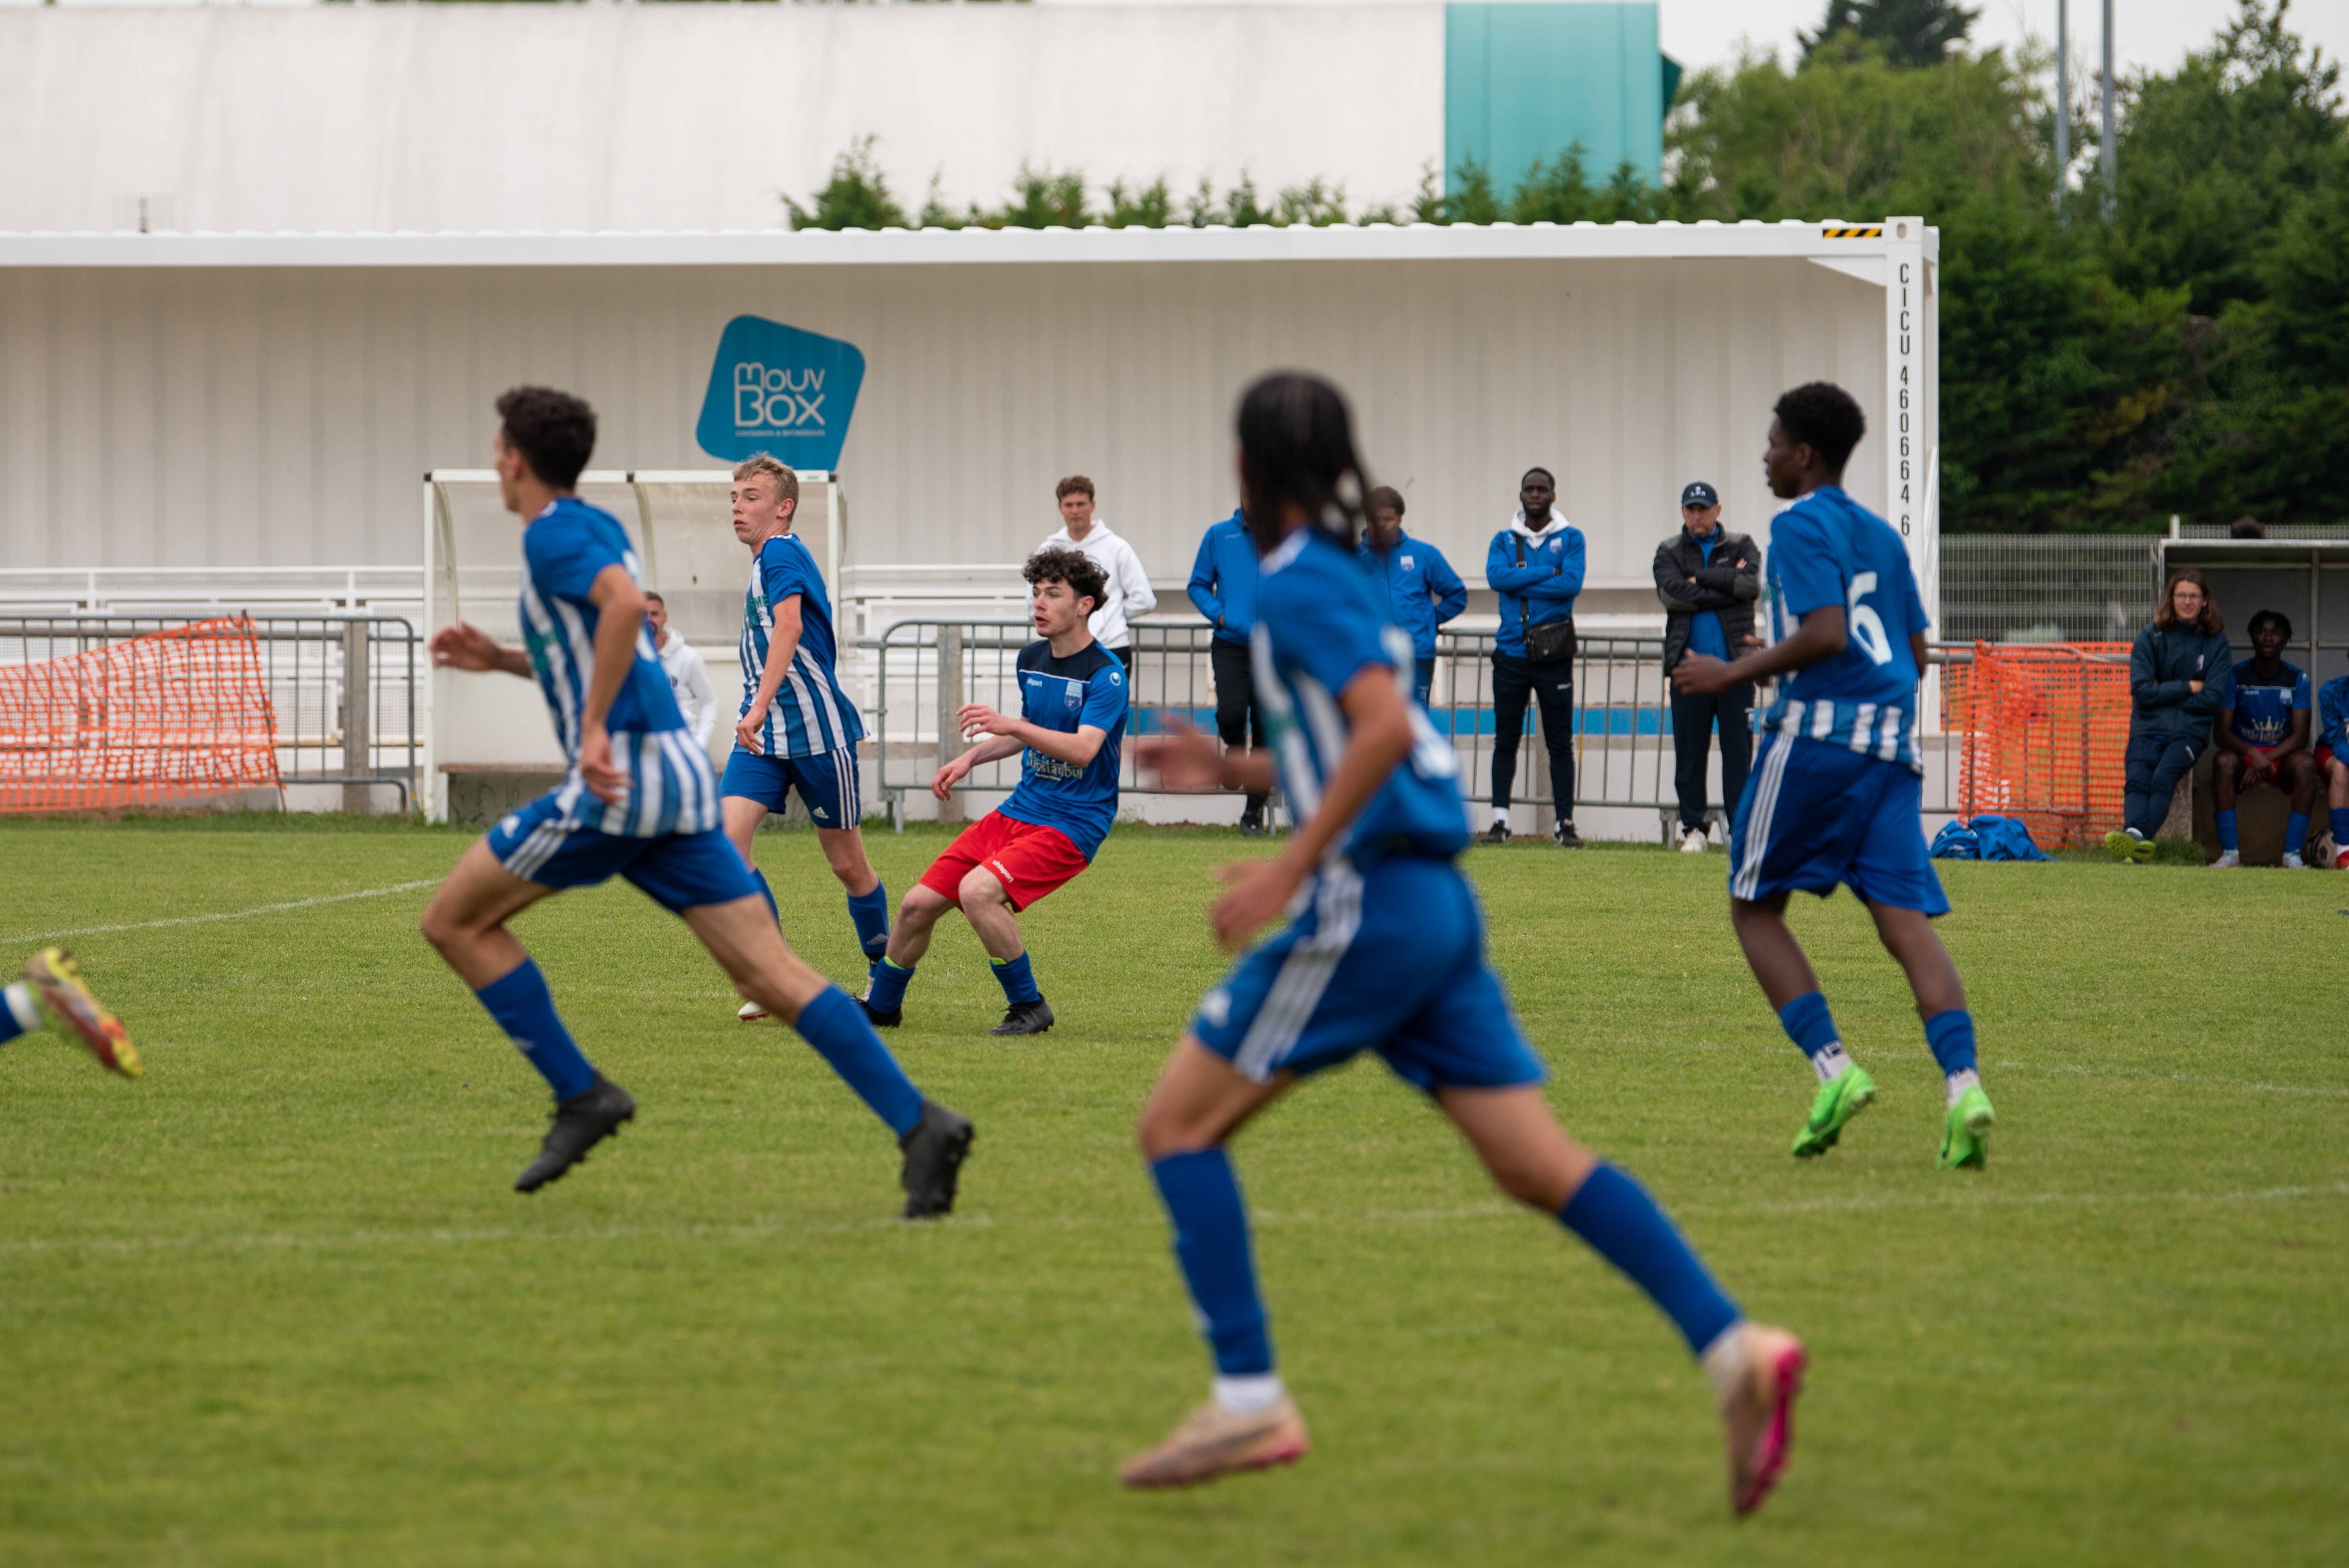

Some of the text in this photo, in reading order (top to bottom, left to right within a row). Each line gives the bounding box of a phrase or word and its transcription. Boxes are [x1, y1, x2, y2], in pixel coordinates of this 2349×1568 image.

[1900, 263, 1910, 537] CICU 460664 6
[1846, 570, 1893, 666] 6
[992, 859, 1014, 883] uhlsport
